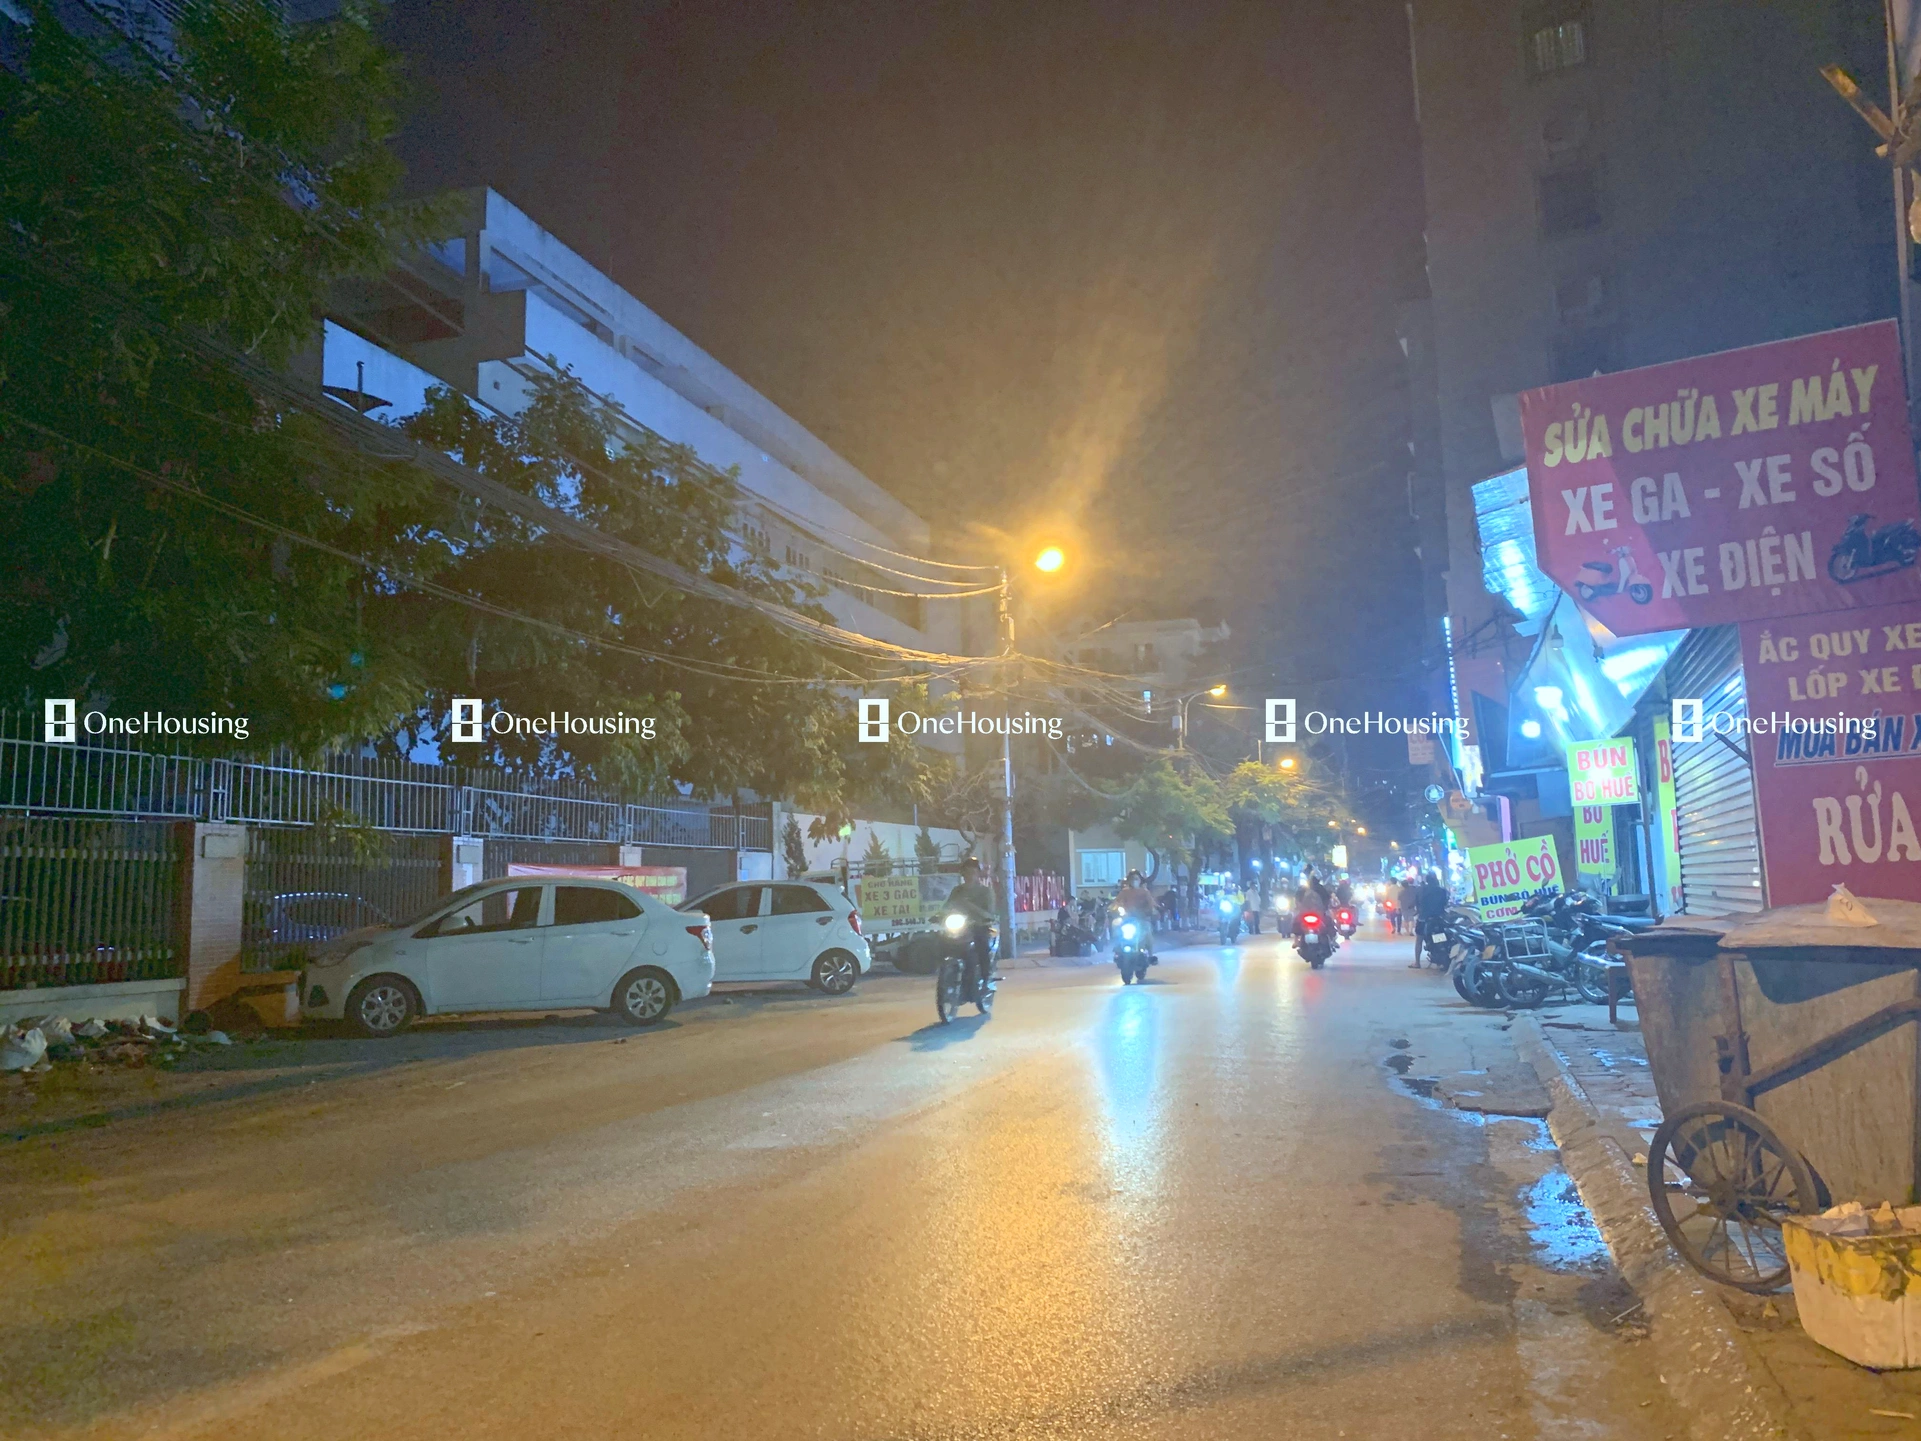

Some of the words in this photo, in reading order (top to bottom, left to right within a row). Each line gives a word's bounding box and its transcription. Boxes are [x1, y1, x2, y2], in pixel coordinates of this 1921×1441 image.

[1543, 402, 1612, 467] SỬA
[1622, 388, 1721, 453] CHỮA
[1730, 383, 1779, 435] XE
[1788, 357, 1879, 427] MÁY
[1561, 483, 1617, 536] XE
[1630, 472, 1691, 525] GA
[1733, 454, 1796, 510] XE
[1810, 421, 1876, 497] SỐ
[1657, 547, 1709, 599] XE
[1719, 526, 1817, 596] ĐIỆN
[1809, 628, 1871, 660] QUY
[1882, 622, 1921, 651] XE
[1788, 665, 1848, 701] LỐP
[1858, 667, 1902, 694] XE
[1777, 720, 1836, 760] MUA
[1845, 708, 1905, 756] BÁN
[1577, 744, 1627, 771] BÚN
[1812, 765, 1921, 865] RỬA
[1475, 847, 1520, 890] PHỞ
[865, 891, 879, 902] XE
[883, 890, 890, 901] 3
[874, 906, 888, 916] XE
